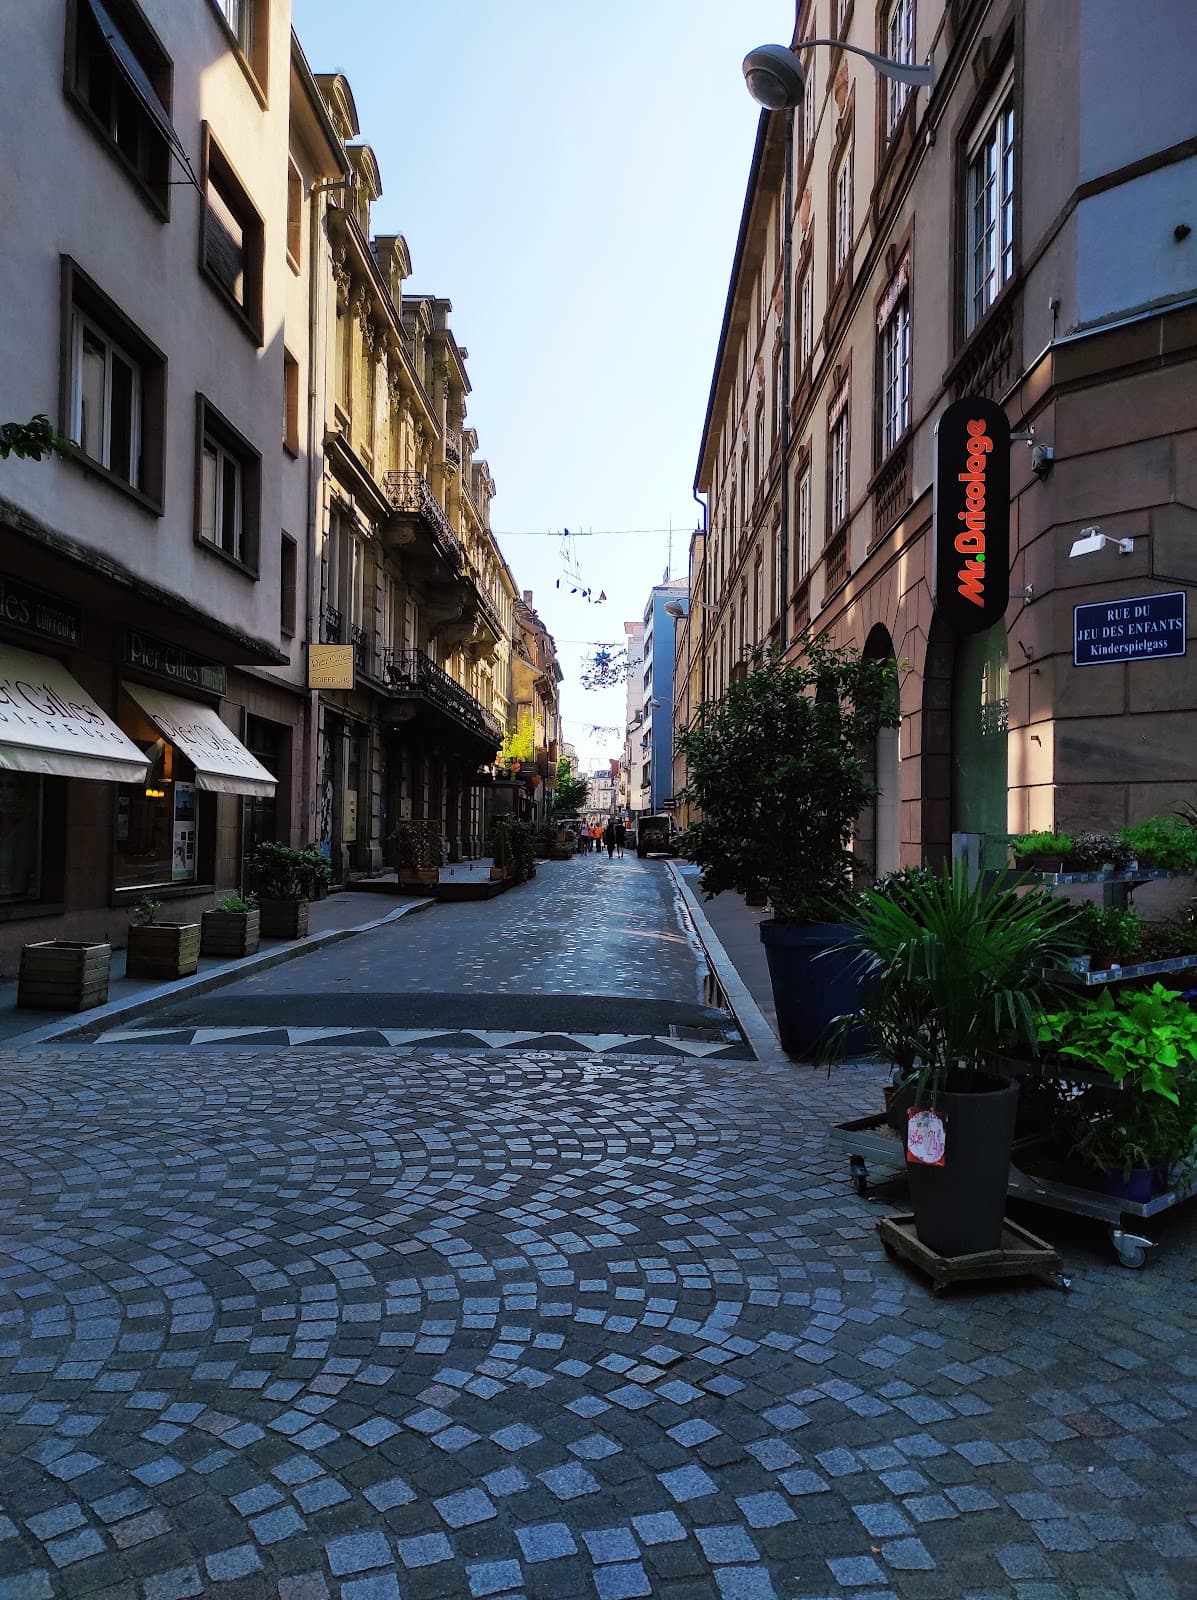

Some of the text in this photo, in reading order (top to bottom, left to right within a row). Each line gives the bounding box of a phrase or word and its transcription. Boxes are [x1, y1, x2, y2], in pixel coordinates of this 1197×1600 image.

[1107, 604, 1151, 621] RUE DU
[1078, 617, 1183, 641] JEU DES ENFANTS
[1091, 639, 1168, 656] Kinderspielgass
